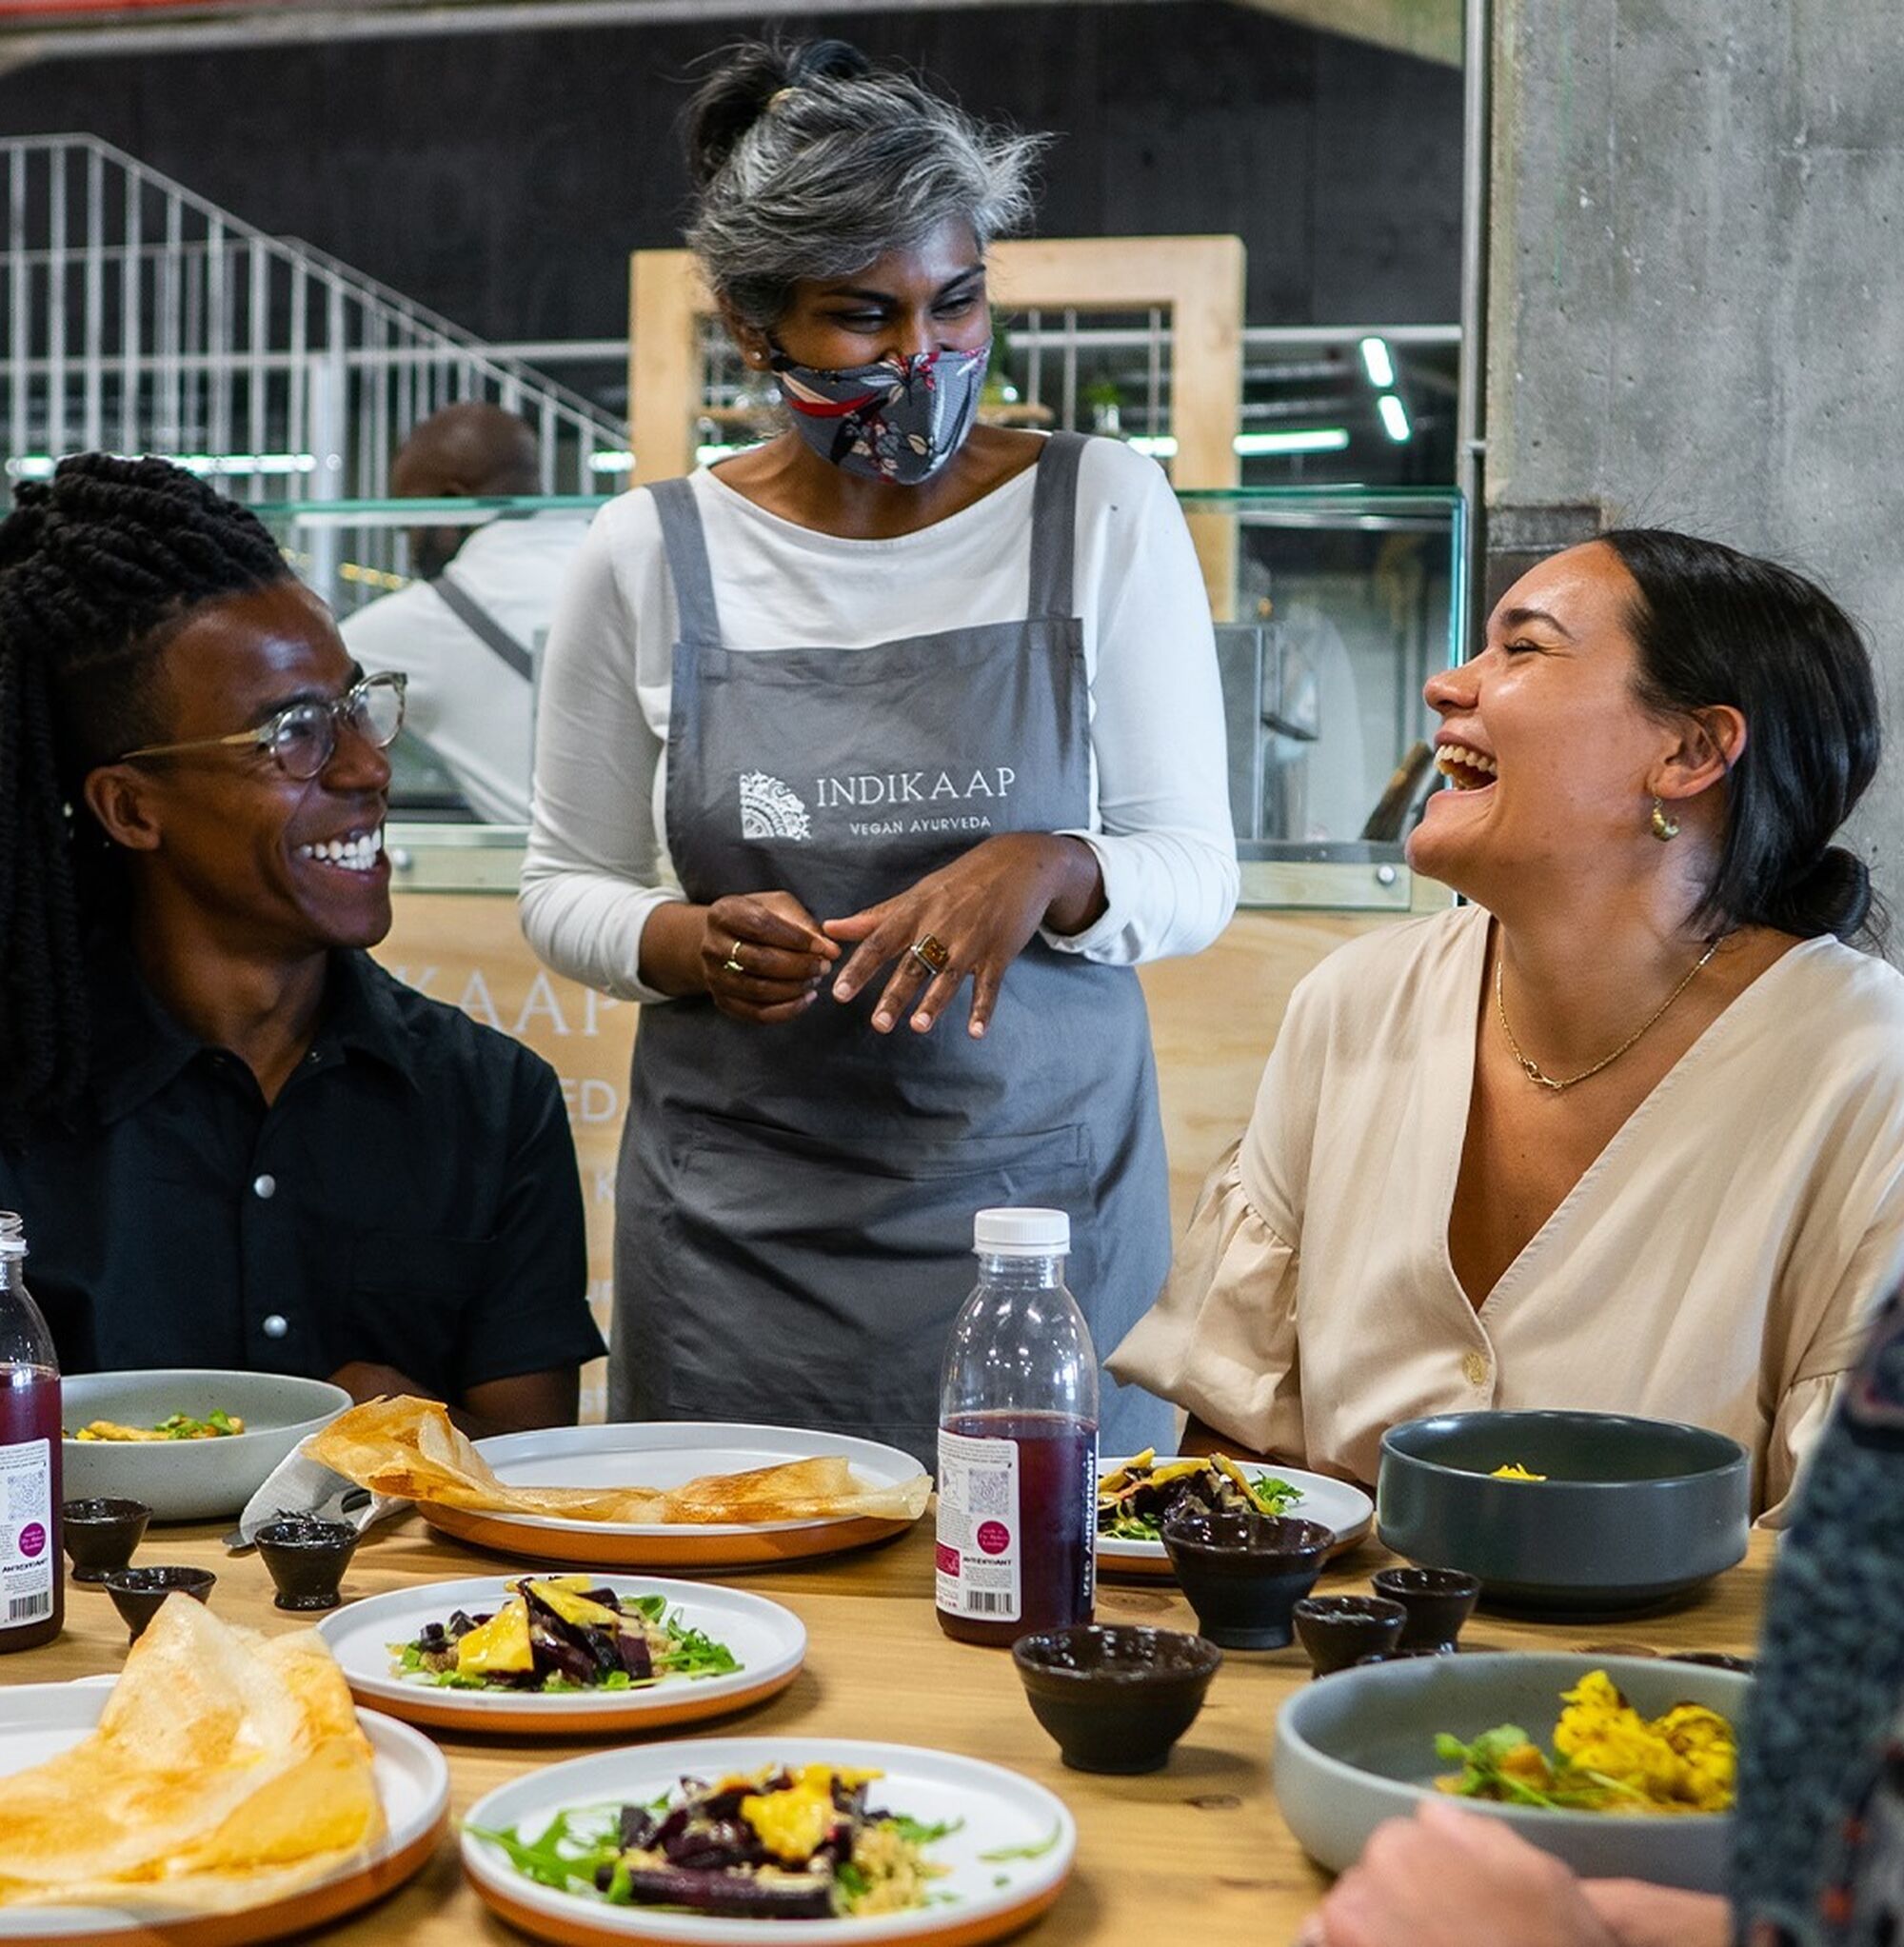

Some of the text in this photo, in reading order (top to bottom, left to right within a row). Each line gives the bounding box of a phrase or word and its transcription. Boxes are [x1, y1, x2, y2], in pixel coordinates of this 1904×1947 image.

[817, 767, 1016, 806] INDIKAAP
[850, 816, 991, 836] VEGAN AYURVEDA
